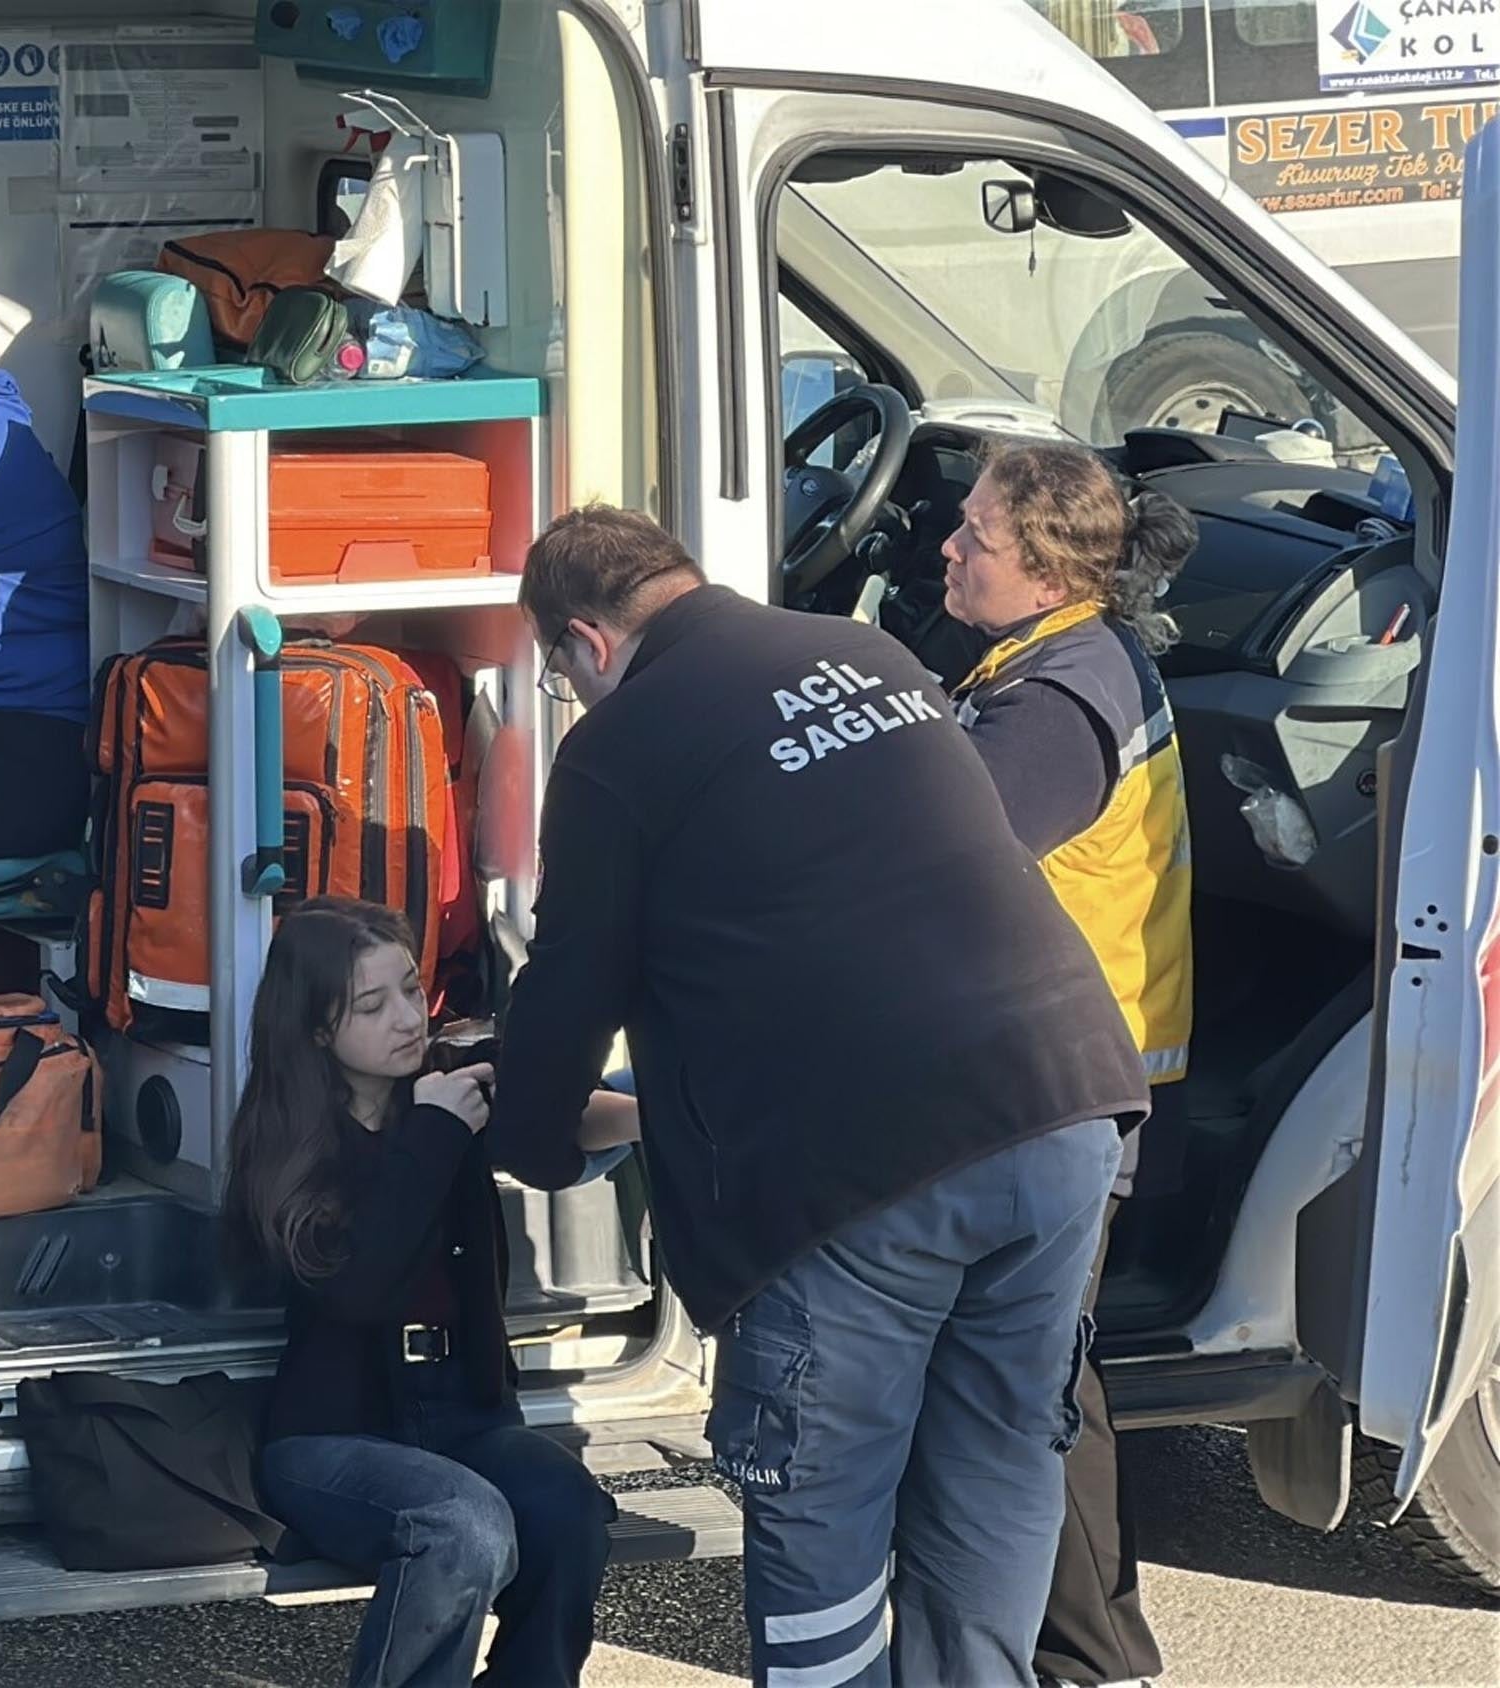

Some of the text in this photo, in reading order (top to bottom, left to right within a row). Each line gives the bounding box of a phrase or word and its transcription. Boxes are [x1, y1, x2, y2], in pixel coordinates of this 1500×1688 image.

[13, 114, 52, 128] ÖNLÜK
[1236, 109, 1408, 164] SEZER
[1276, 162, 1380, 186] Kusursuz
[1384, 152, 1429, 179] Tek
[769, 688, 942, 772] SAĞLIK
